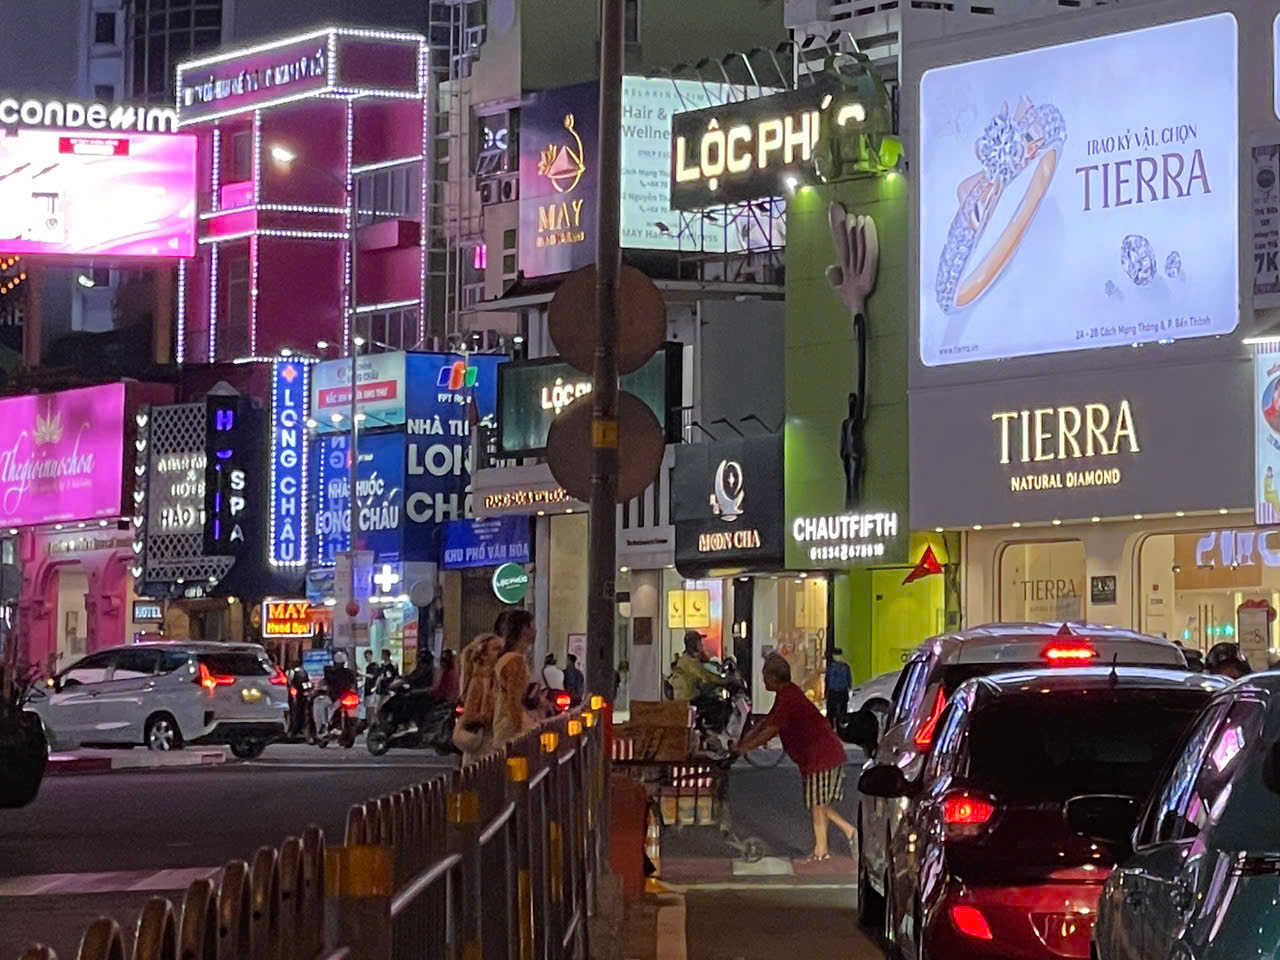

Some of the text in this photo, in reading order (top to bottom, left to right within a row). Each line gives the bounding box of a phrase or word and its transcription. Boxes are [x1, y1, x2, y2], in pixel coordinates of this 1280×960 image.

[623, 105, 656, 121] Hair
[622, 124, 670, 140] Wellne
[676, 117, 752, 191] LỘC
[1075, 148, 1212, 211] TIERRA
[538, 198, 584, 233] MAY
[1254, 250, 1279, 274] 7K
[407, 415, 444, 435] NHÀ
[991, 399, 1140, 465] TIERRA
[280, 389, 298, 561] LONG CHÂU
[356, 472, 385, 497] HUỐC
[1011, 468, 1121, 492] NATURAL DIAMOND
[793, 511, 898, 542] CHAUTFIFTH
[734, 529, 761, 550] CHA
[444, 548, 463, 563] KHU
[466, 541, 486, 562] PHỐ
[1020, 577, 1077, 603] TIERRA
[135, 606, 162, 618] HOTEL
[268, 603, 309, 620] MAY
